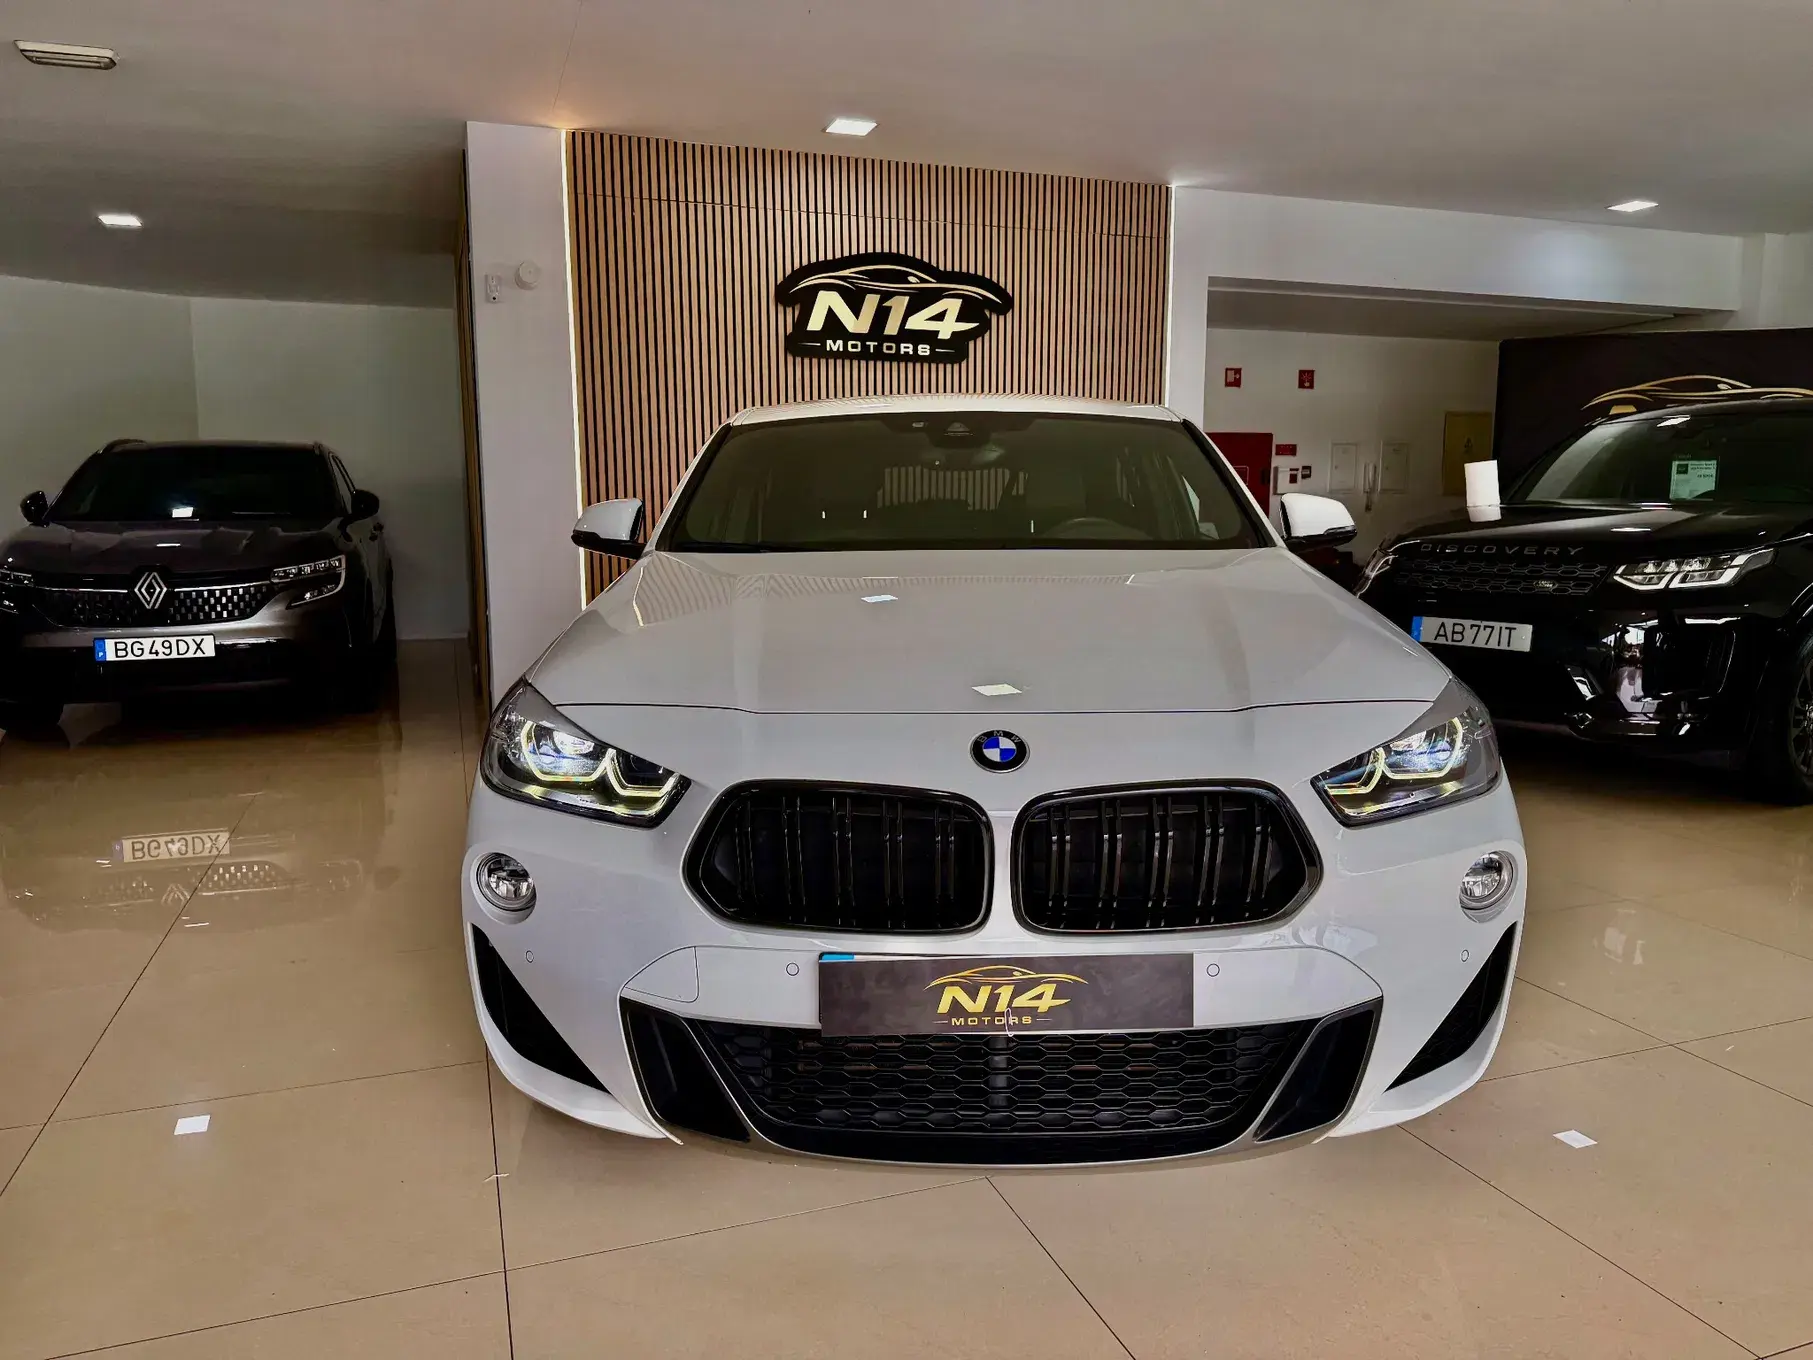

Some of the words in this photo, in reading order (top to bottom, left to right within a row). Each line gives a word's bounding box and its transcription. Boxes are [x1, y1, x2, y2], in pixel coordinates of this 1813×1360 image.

[807, 290, 980, 340] N14
[826, 339, 931, 356] MOTORS
[1420, 543, 1584, 556] DISCOVERY
[114, 637, 206, 659] BG49DX
[977, 730, 1022, 743] BMW
[936, 983, 1072, 1014] N14
[951, 1015, 1033, 1026] MOTORS
